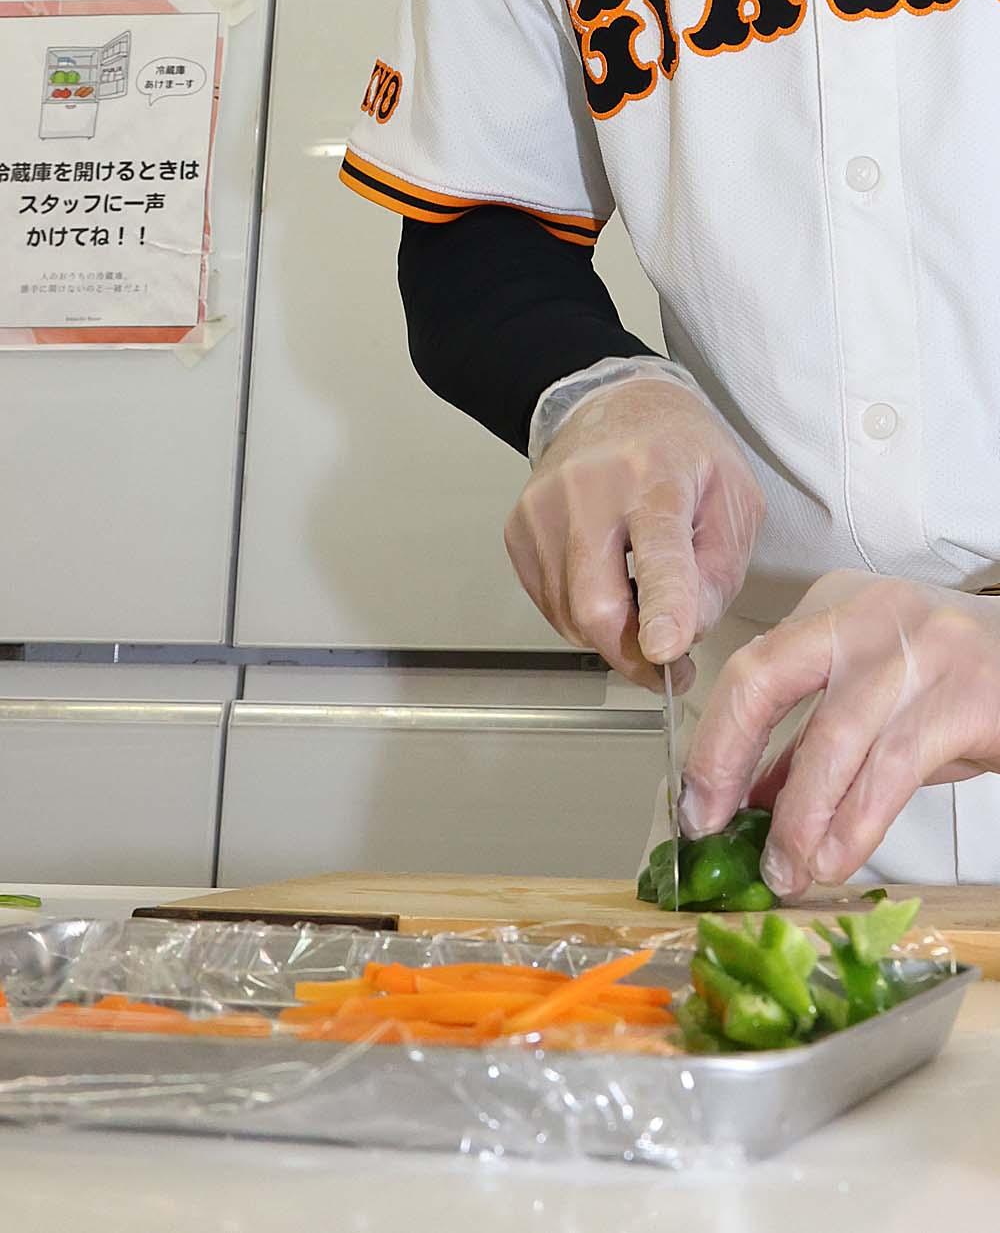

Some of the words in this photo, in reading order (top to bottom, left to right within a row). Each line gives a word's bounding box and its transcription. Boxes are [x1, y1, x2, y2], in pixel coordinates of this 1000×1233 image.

[144, 79, 195, 89] あけまーす
[19, 193, 166, 214] スタッフに一声
[27, 226, 145, 247] かけてね！！
